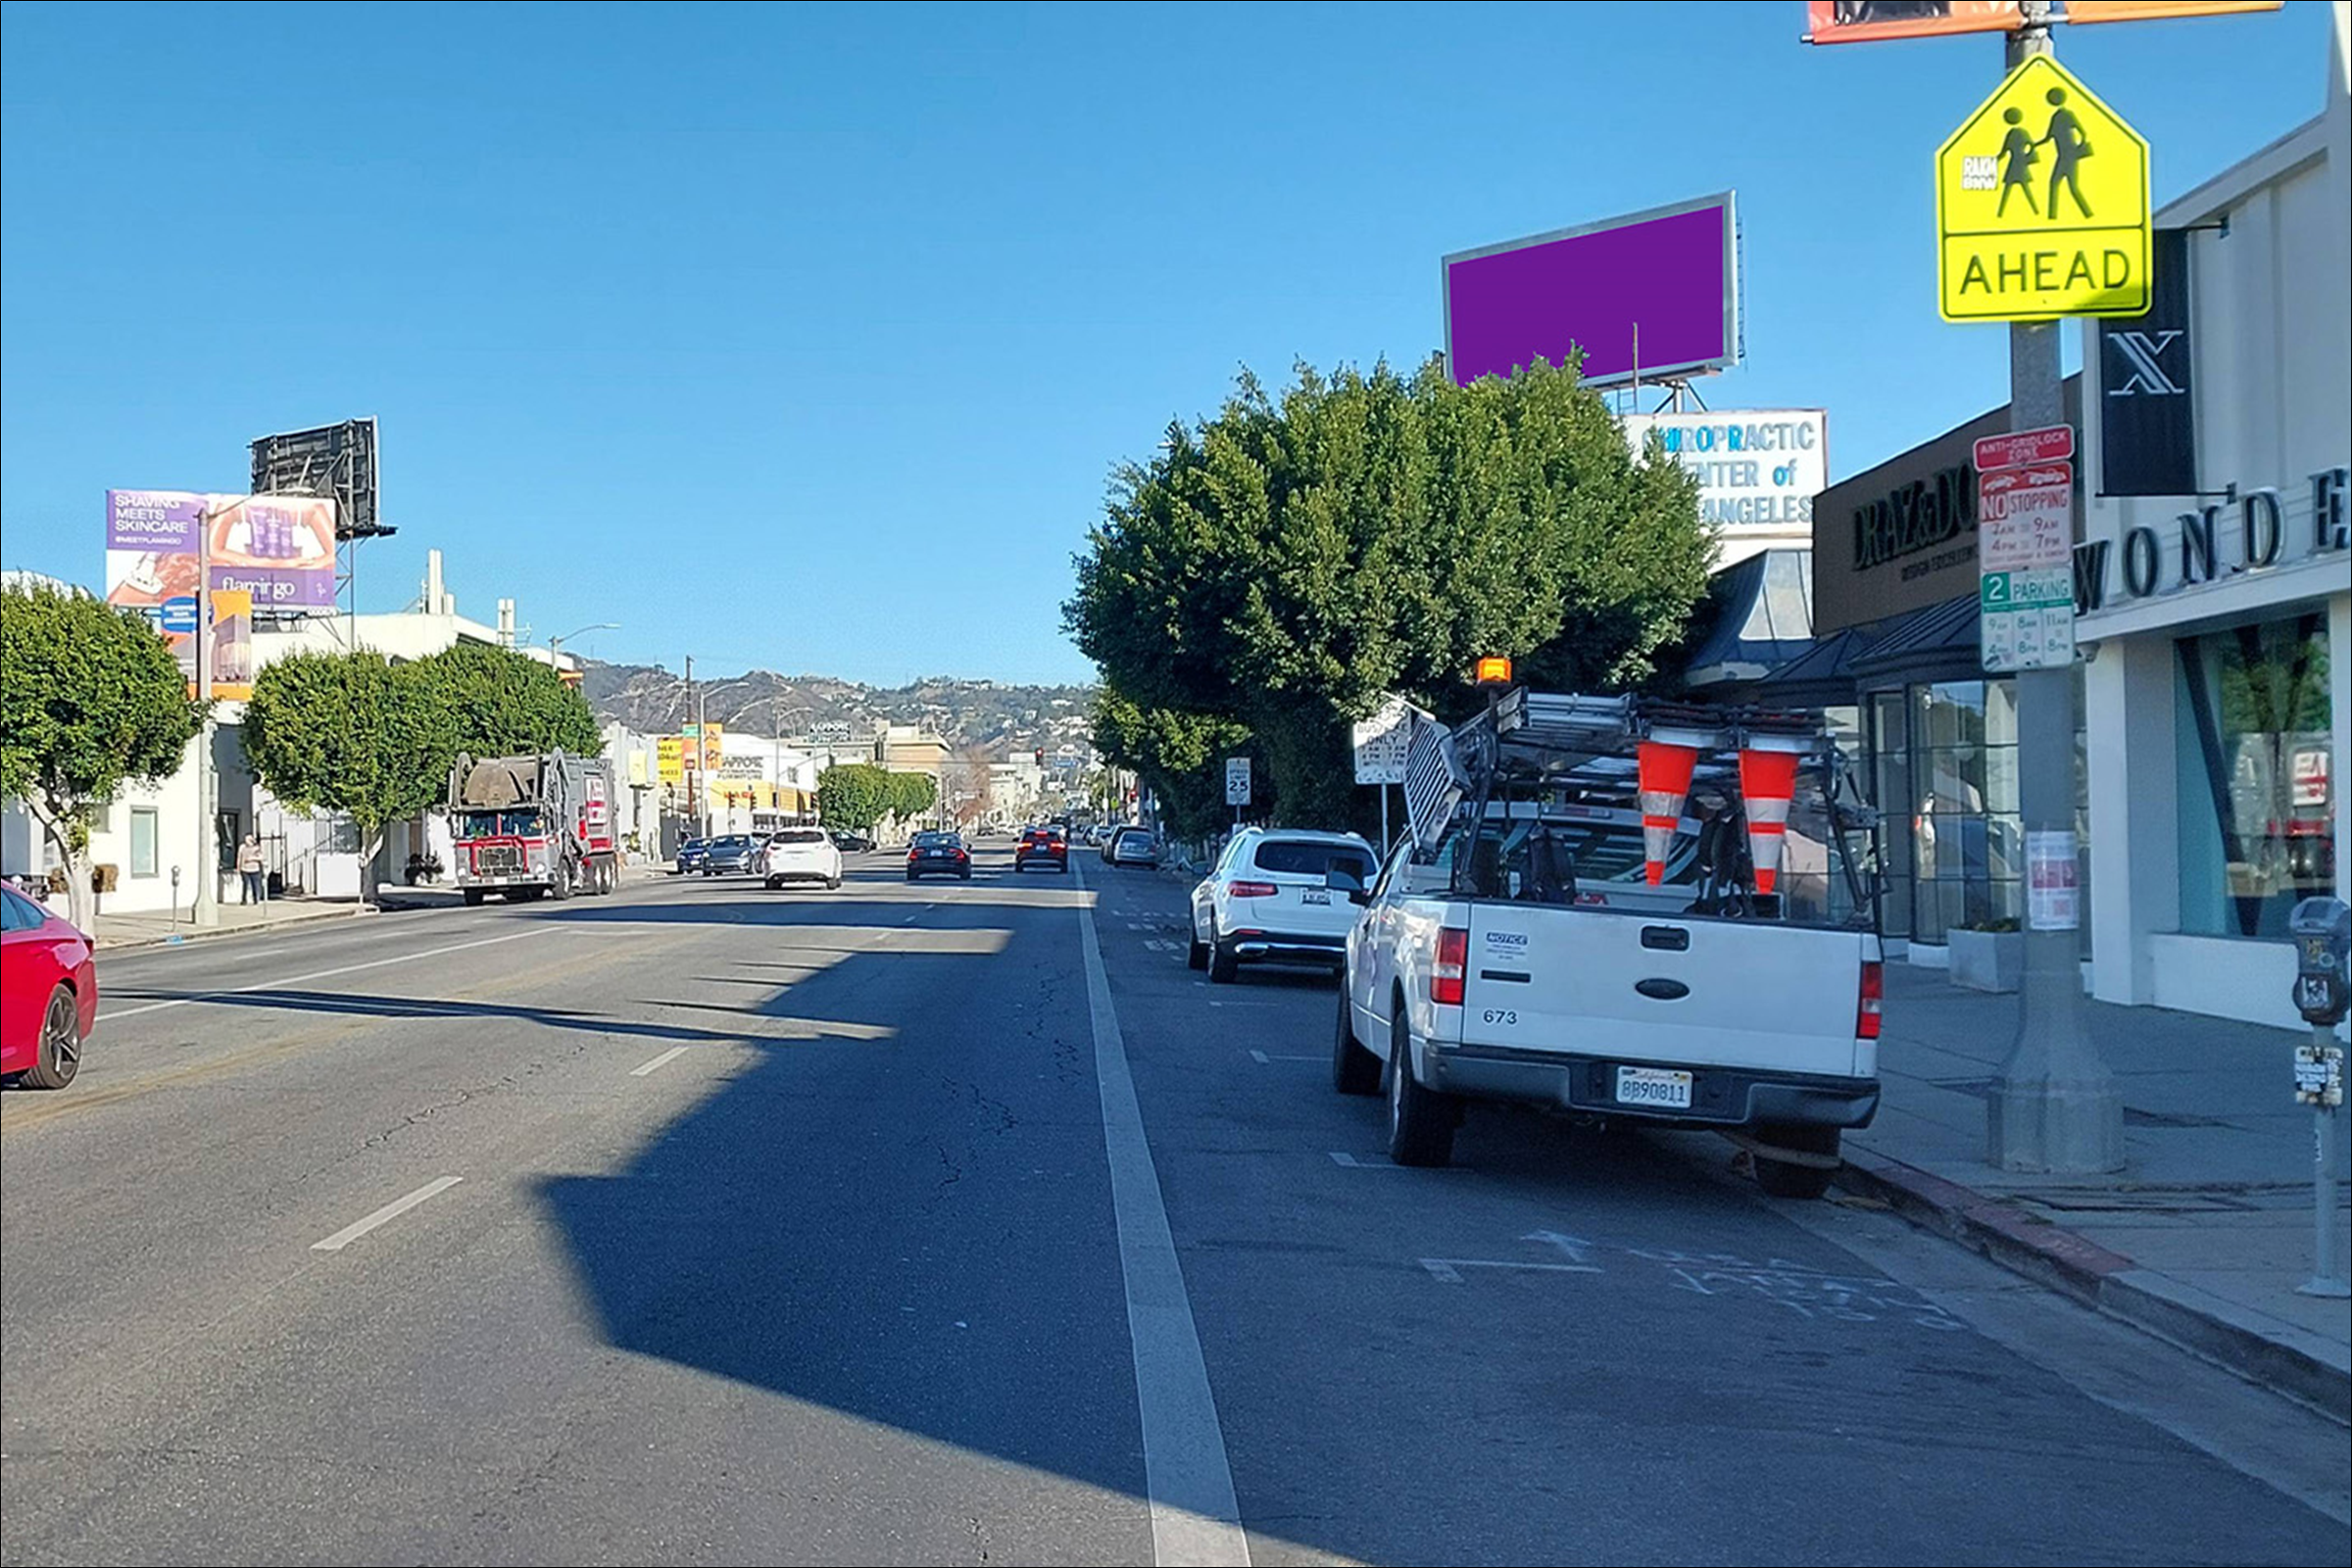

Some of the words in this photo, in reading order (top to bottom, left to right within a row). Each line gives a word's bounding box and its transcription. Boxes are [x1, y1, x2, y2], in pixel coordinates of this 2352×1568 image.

[1959, 249, 2131, 295] AHEAD
[1981, 431, 2068, 455] ANTI-GRIDLOCK
[2008, 447, 2038, 462] ZONE
[1772, 458, 1797, 486] of
[115, 494, 180, 509] SHAVING
[1982, 494, 2008, 521] NO
[2010, 489, 2069, 514] STOPPING
[116, 508, 165, 520] MEETS
[115, 519, 189, 534] SKINCARE
[1988, 575, 2004, 600] 2
[2013, 578, 2069, 601] PARKING
[1367, 735, 1398, 745] ONLY
[1229, 780, 1250, 792] 25
[1483, 1009, 1518, 1025] 673
